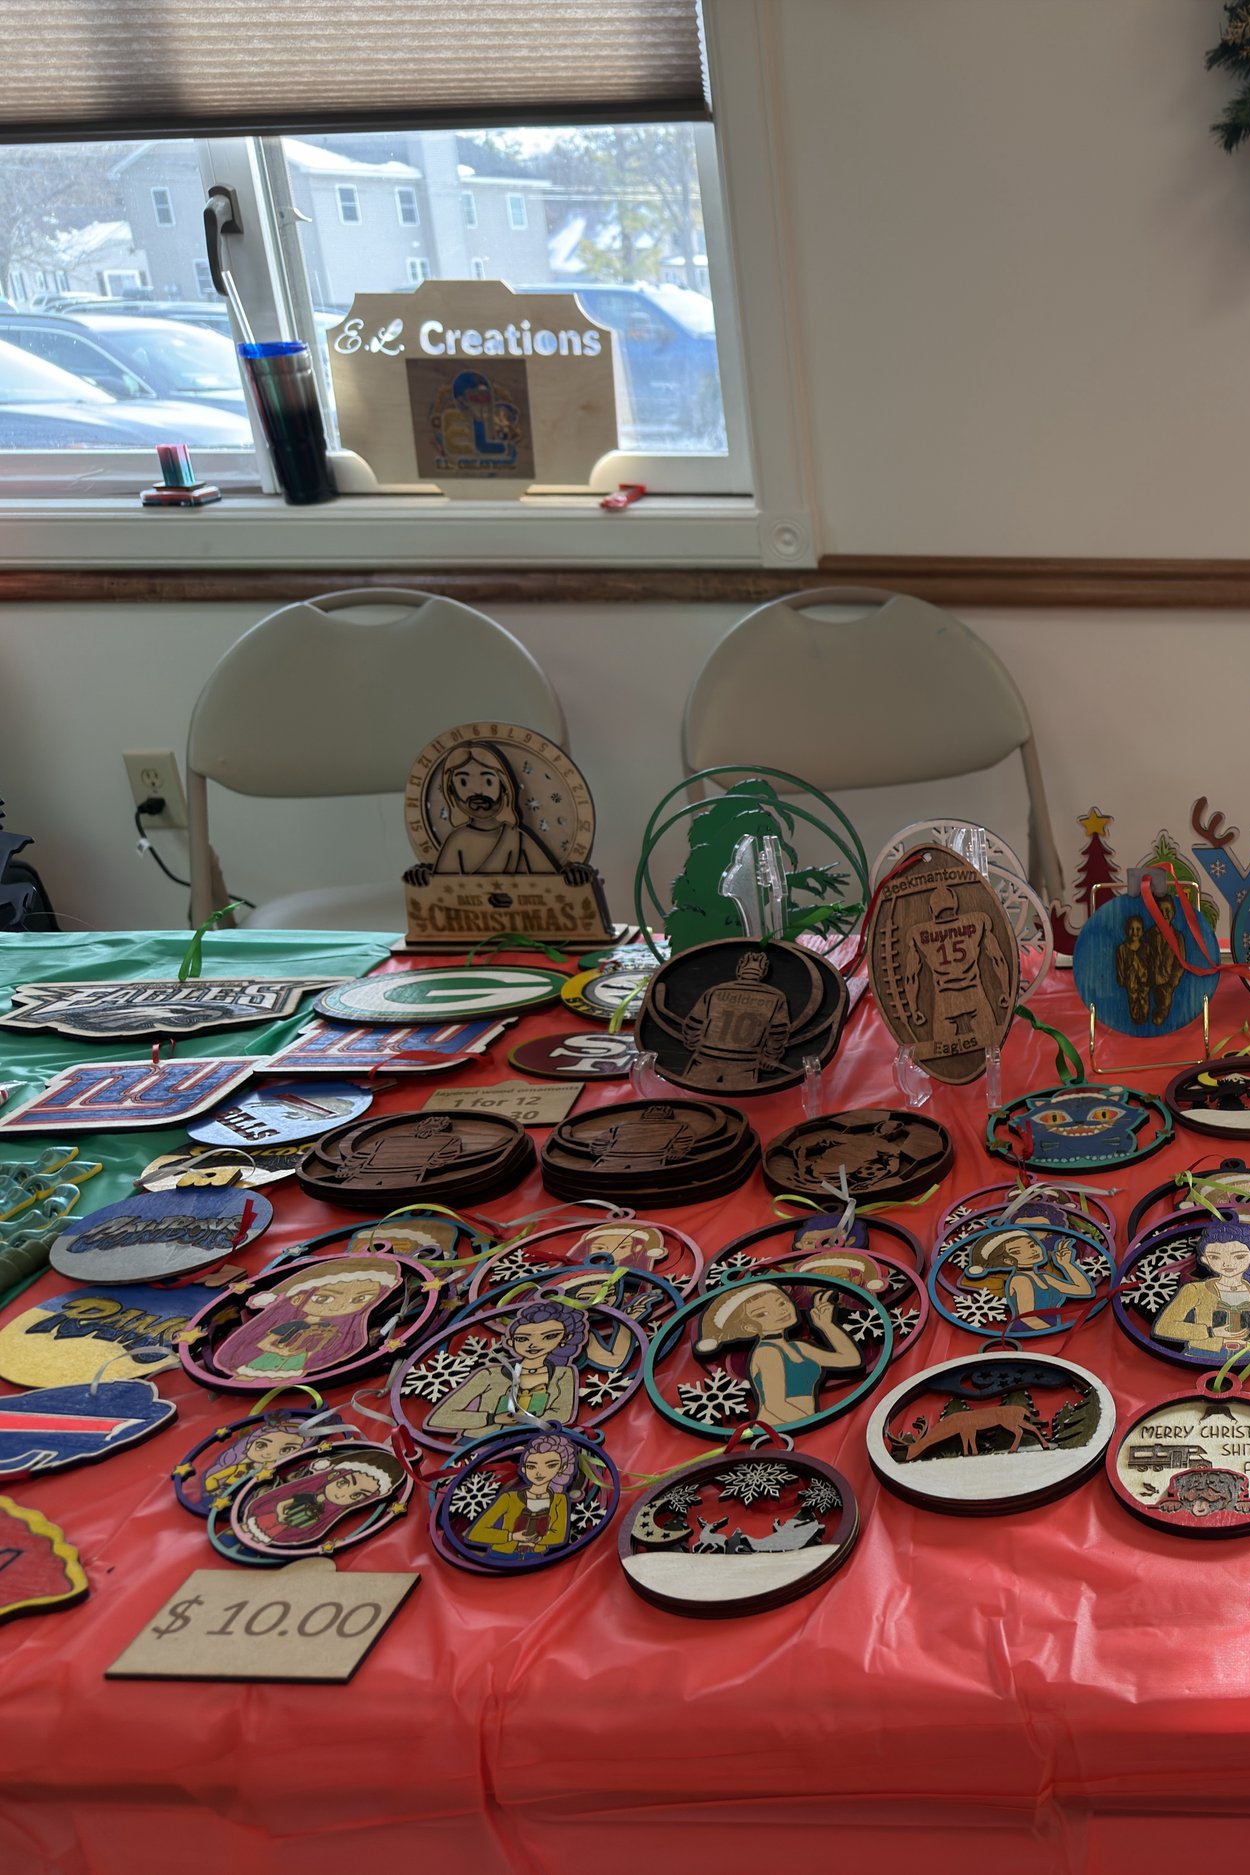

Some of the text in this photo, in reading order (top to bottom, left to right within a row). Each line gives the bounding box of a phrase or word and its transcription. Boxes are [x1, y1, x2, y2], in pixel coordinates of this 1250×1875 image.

[419, 319, 602, 357] Creations
[881, 868, 979, 896] Beekmantown
[427, 903, 579, 934] CHRISTMAS
[935, 940, 969, 967] 15
[50, 984, 287, 1011] EAGLES
[339, 971, 554, 1013] G
[719, 1010, 765, 1045] 10
[933, 1036, 979, 1056] Eagles
[453, 1096, 543, 1108] 1 for 12
[509, 1110, 540, 1120] 30
[1141, 1425, 1195, 1440] MERRY
[151, 1594, 382, 1640] $ 10.00
